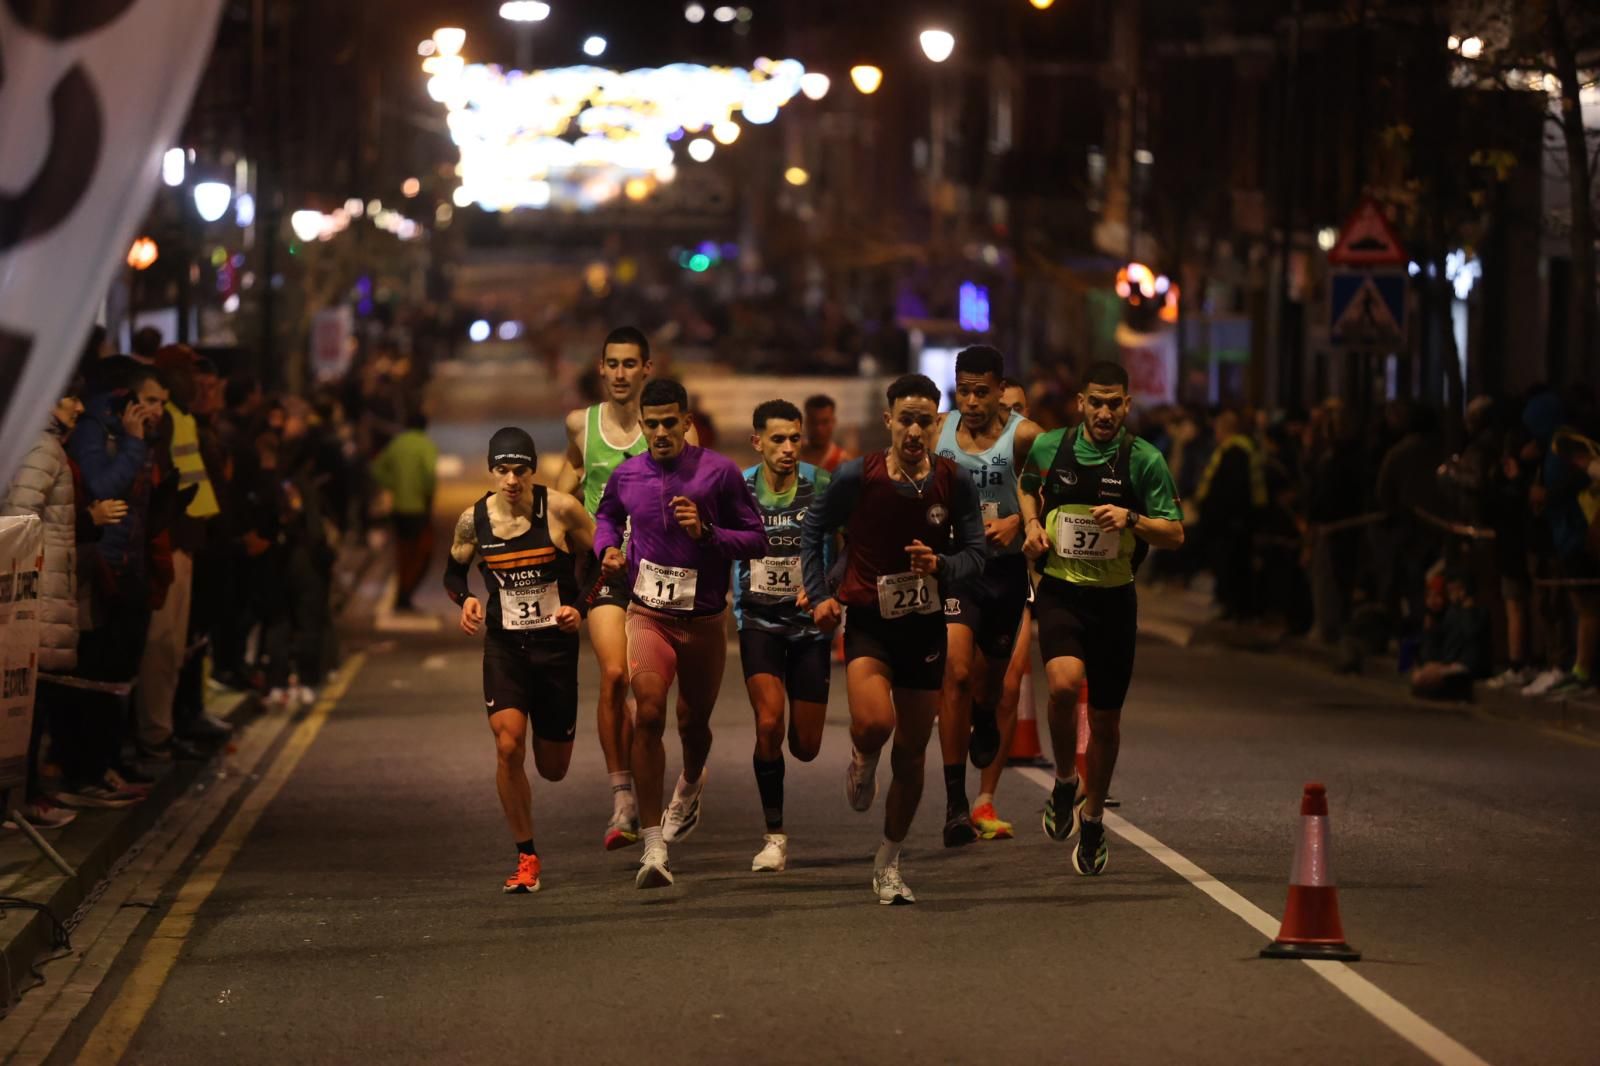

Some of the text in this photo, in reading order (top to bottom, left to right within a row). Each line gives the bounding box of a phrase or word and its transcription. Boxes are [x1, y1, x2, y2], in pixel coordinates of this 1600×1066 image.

[969, 465, 1003, 488] rja
[768, 514, 792, 526] TRIBE
[1073, 530, 1100, 549] 37
[510, 570, 541, 581] VICKY
[645, 564, 654, 572] EL
[654, 567, 686, 578] CORREO
[766, 571, 792, 587] 34
[515, 587, 547, 596] CORREO
[656, 580, 675, 601] 11
[892, 586, 930, 609] 220
[518, 600, 542, 619] 31
[520, 615, 551, 626] CORREO
